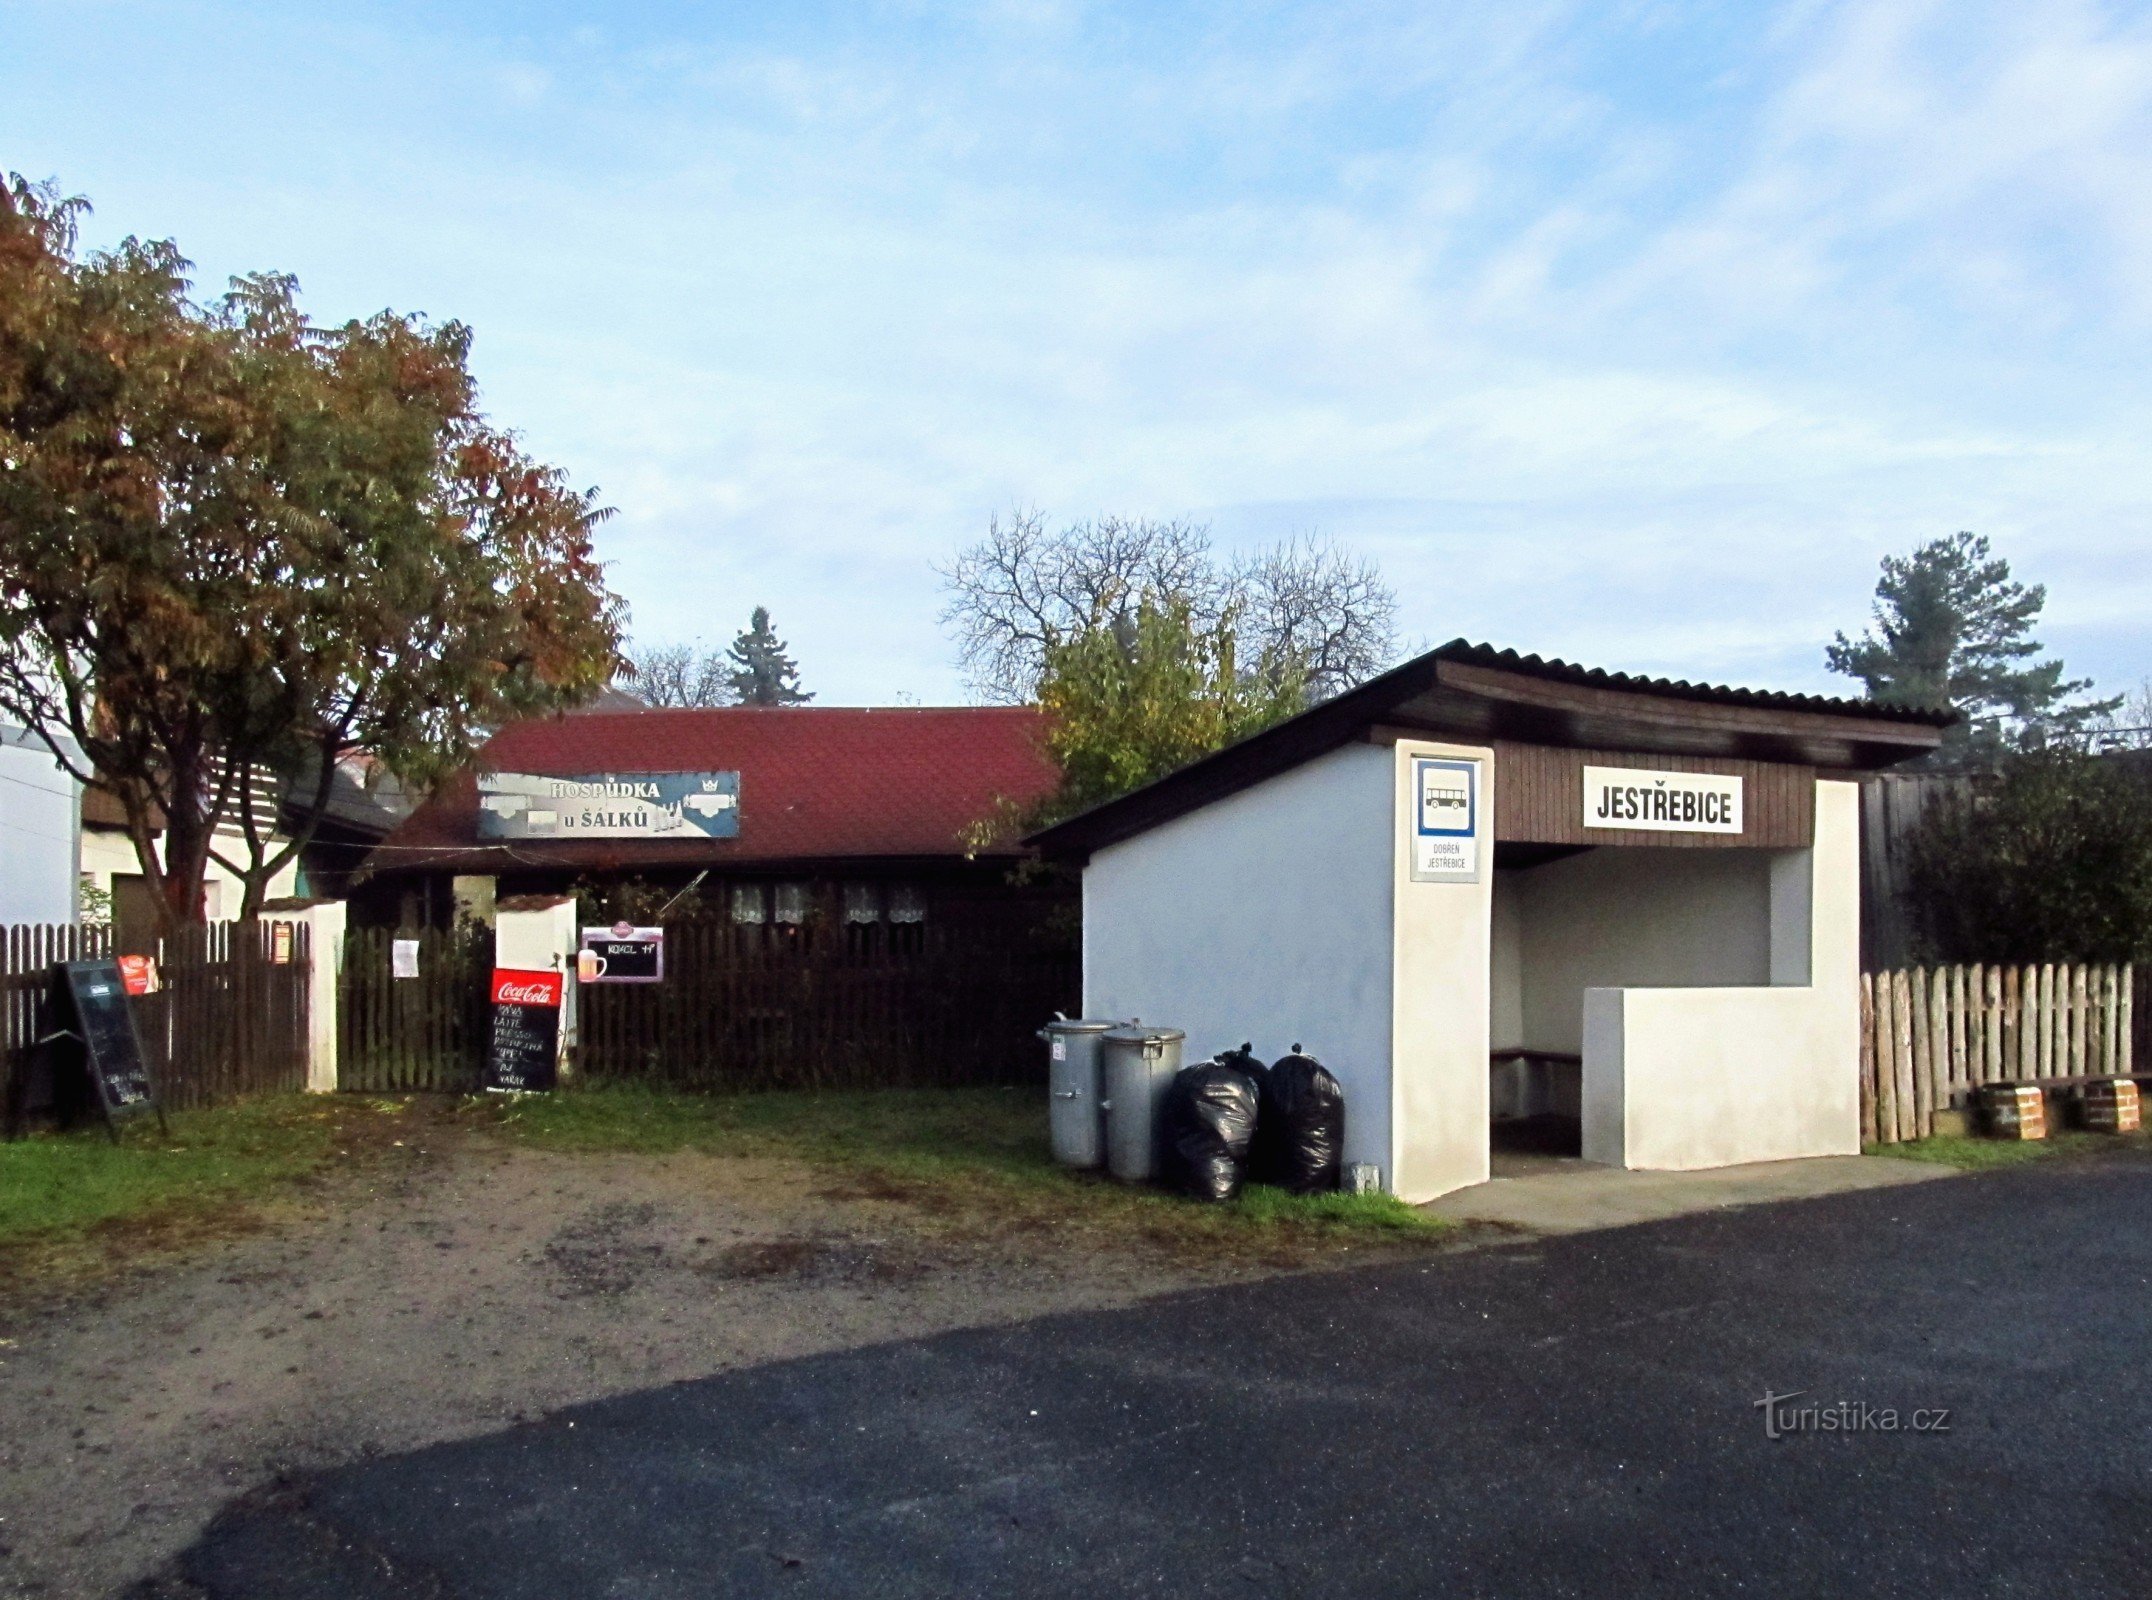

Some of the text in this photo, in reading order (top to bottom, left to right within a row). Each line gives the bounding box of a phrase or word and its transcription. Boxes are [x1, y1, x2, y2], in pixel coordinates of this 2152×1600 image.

[550, 776, 660, 798] HOSPŮDKA
[1597, 779, 1732, 824] JESTŘEBICE
[564, 805, 648, 828] u ŠÁLKŮ
[1427, 857, 1466, 869] JESTŘEBICE
[498, 982, 553, 1004] Coca-Cola
